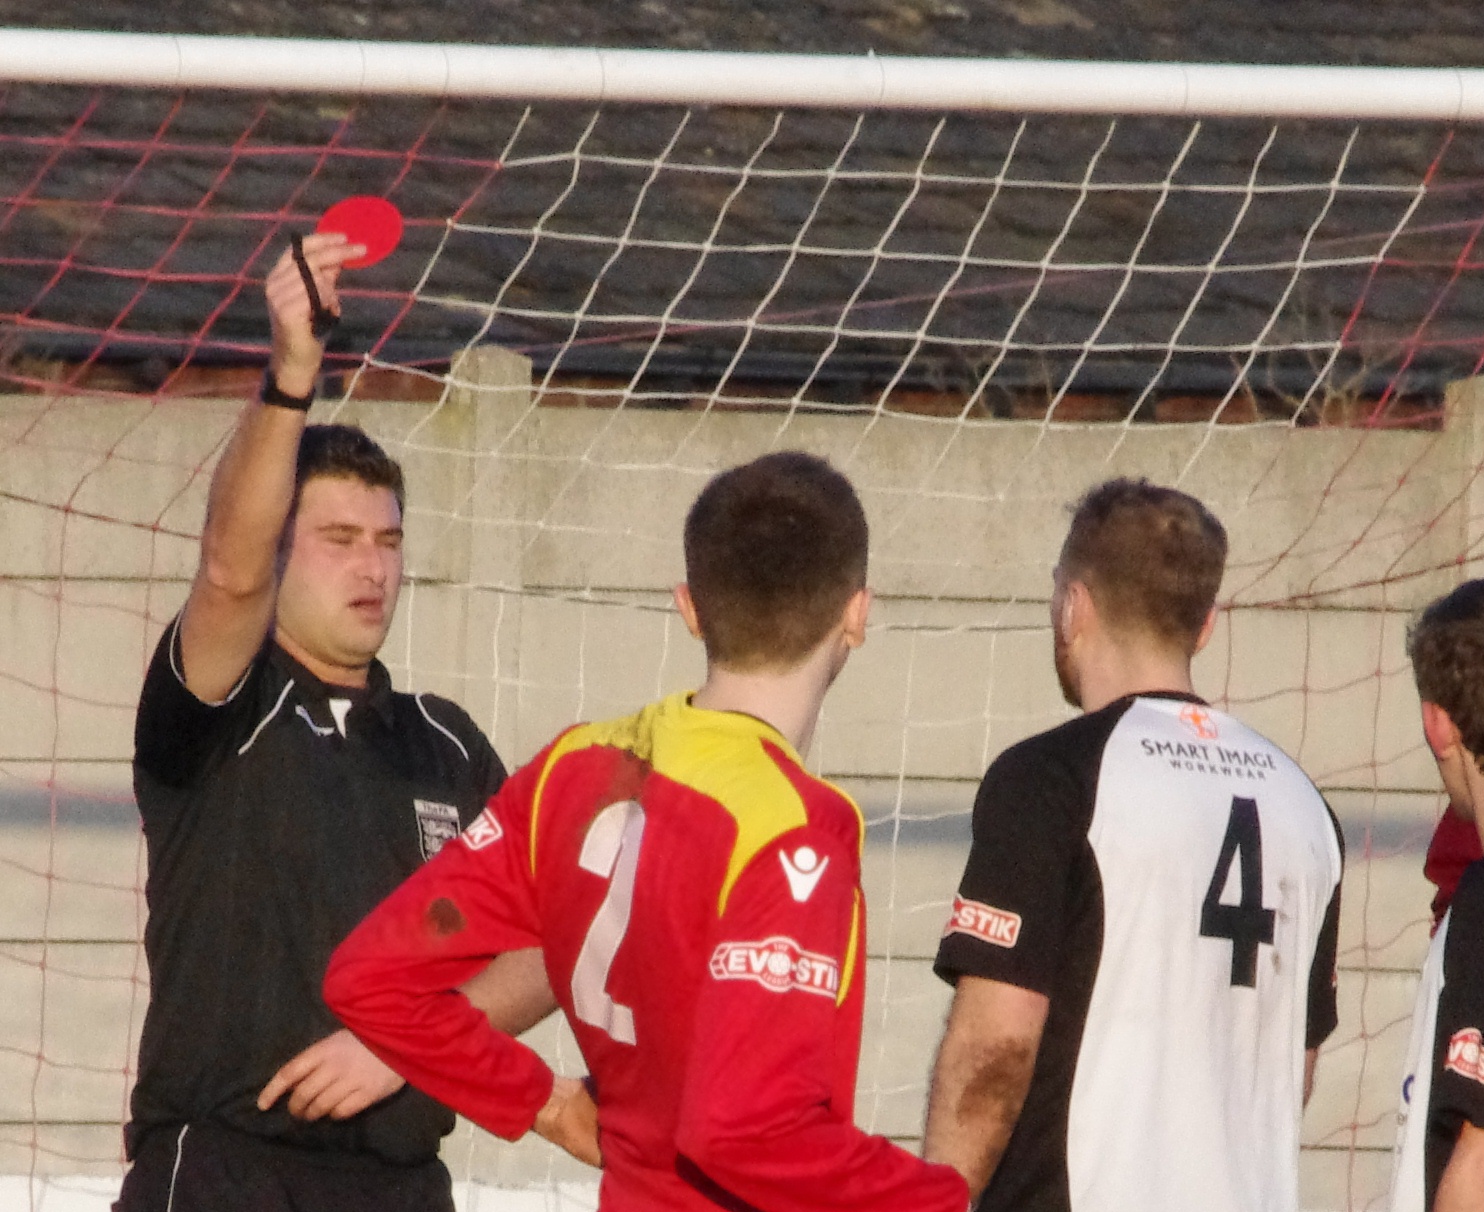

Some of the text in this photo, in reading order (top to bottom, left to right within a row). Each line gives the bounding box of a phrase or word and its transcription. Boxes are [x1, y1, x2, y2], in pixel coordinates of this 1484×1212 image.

[1141, 738, 1277, 771] SMART IMAGE
[1170, 759, 1266, 781] WORKWEAR
[1199, 795, 1276, 989] 4
[571, 800, 647, 1047] 2
[728, 949, 838, 990] EVO-STI
